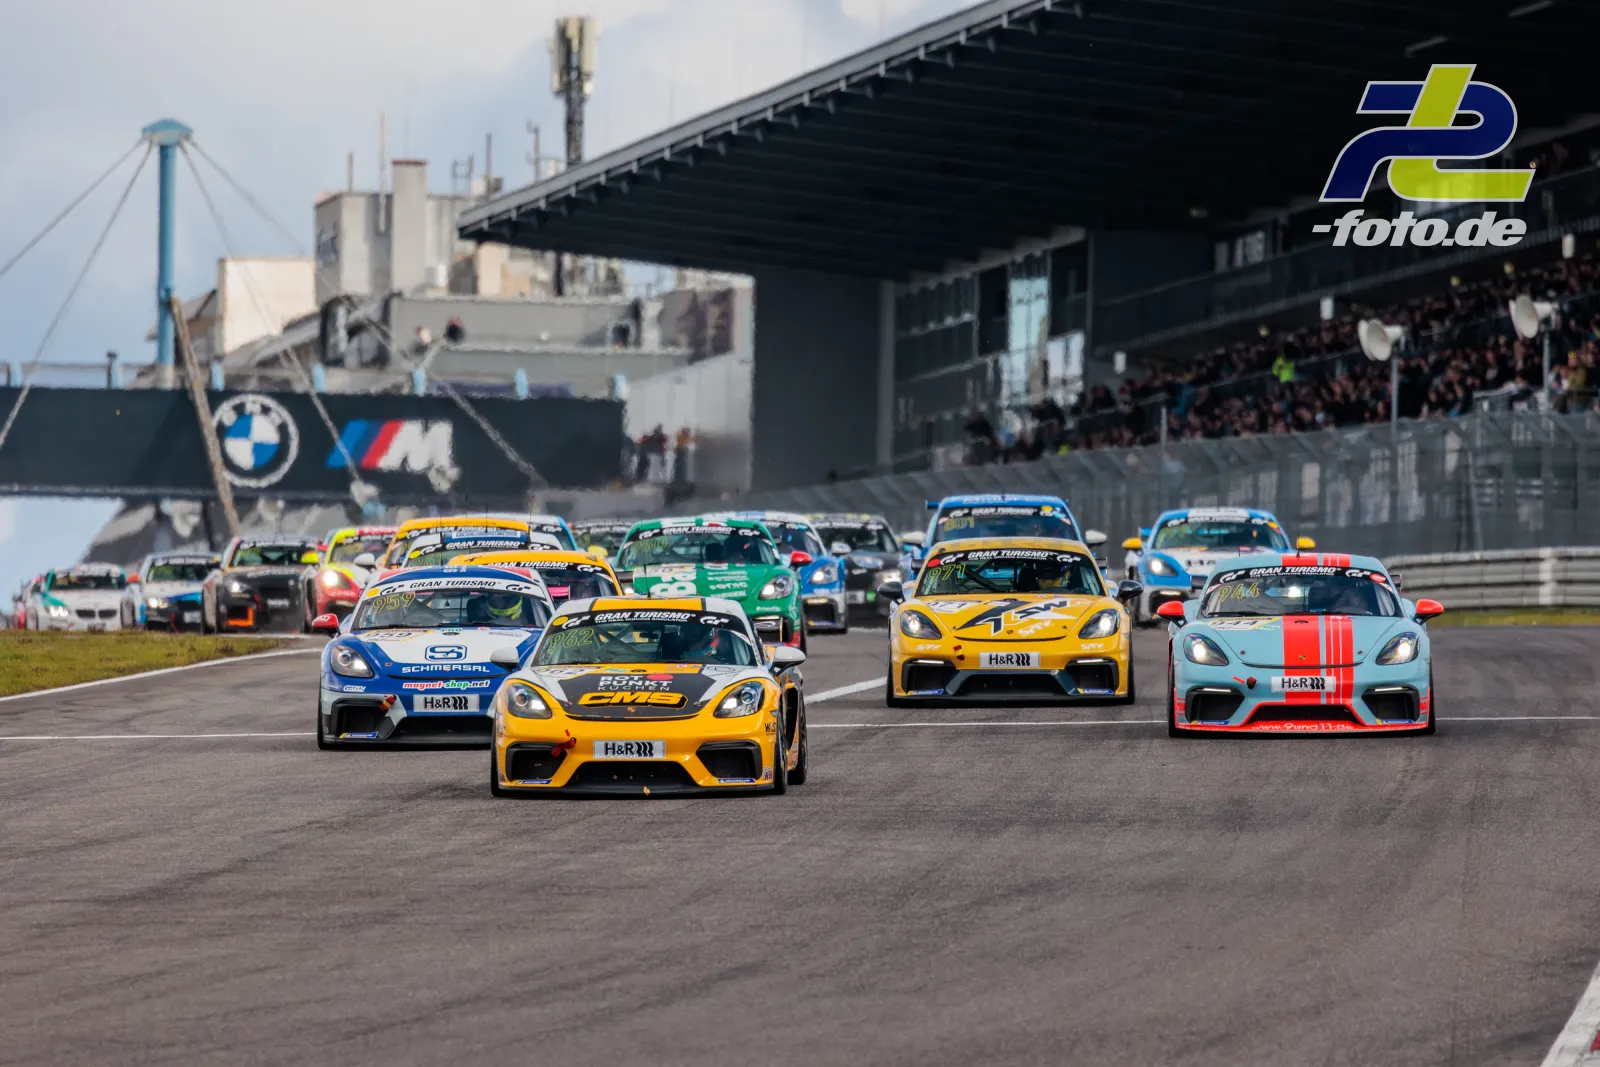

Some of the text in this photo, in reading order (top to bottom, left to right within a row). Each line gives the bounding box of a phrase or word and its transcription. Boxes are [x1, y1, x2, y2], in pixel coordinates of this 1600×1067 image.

[445, 541, 475, 549] GRAN
[967, 550, 1049, 559] GRAN TURISMO
[928, 563, 967, 582] 971
[1250, 566, 1337, 576] GRAN TURISMO
[409, 580, 497, 589] GRAN TURISMO
[1218, 582, 1260, 602] 944
[372, 592, 416, 614] 959
[594, 611, 691, 621] GRAN TURISMO
[989, 653, 1015, 665] H&R
[401, 663, 491, 674] SCHMERSAL
[402, 679, 491, 690] magnet-shop.net
[1281, 677, 1309, 690] H&R
[424, 697, 451, 710] H&R
[577, 690, 684, 706] CMS
[604, 742, 636, 756] H&R
